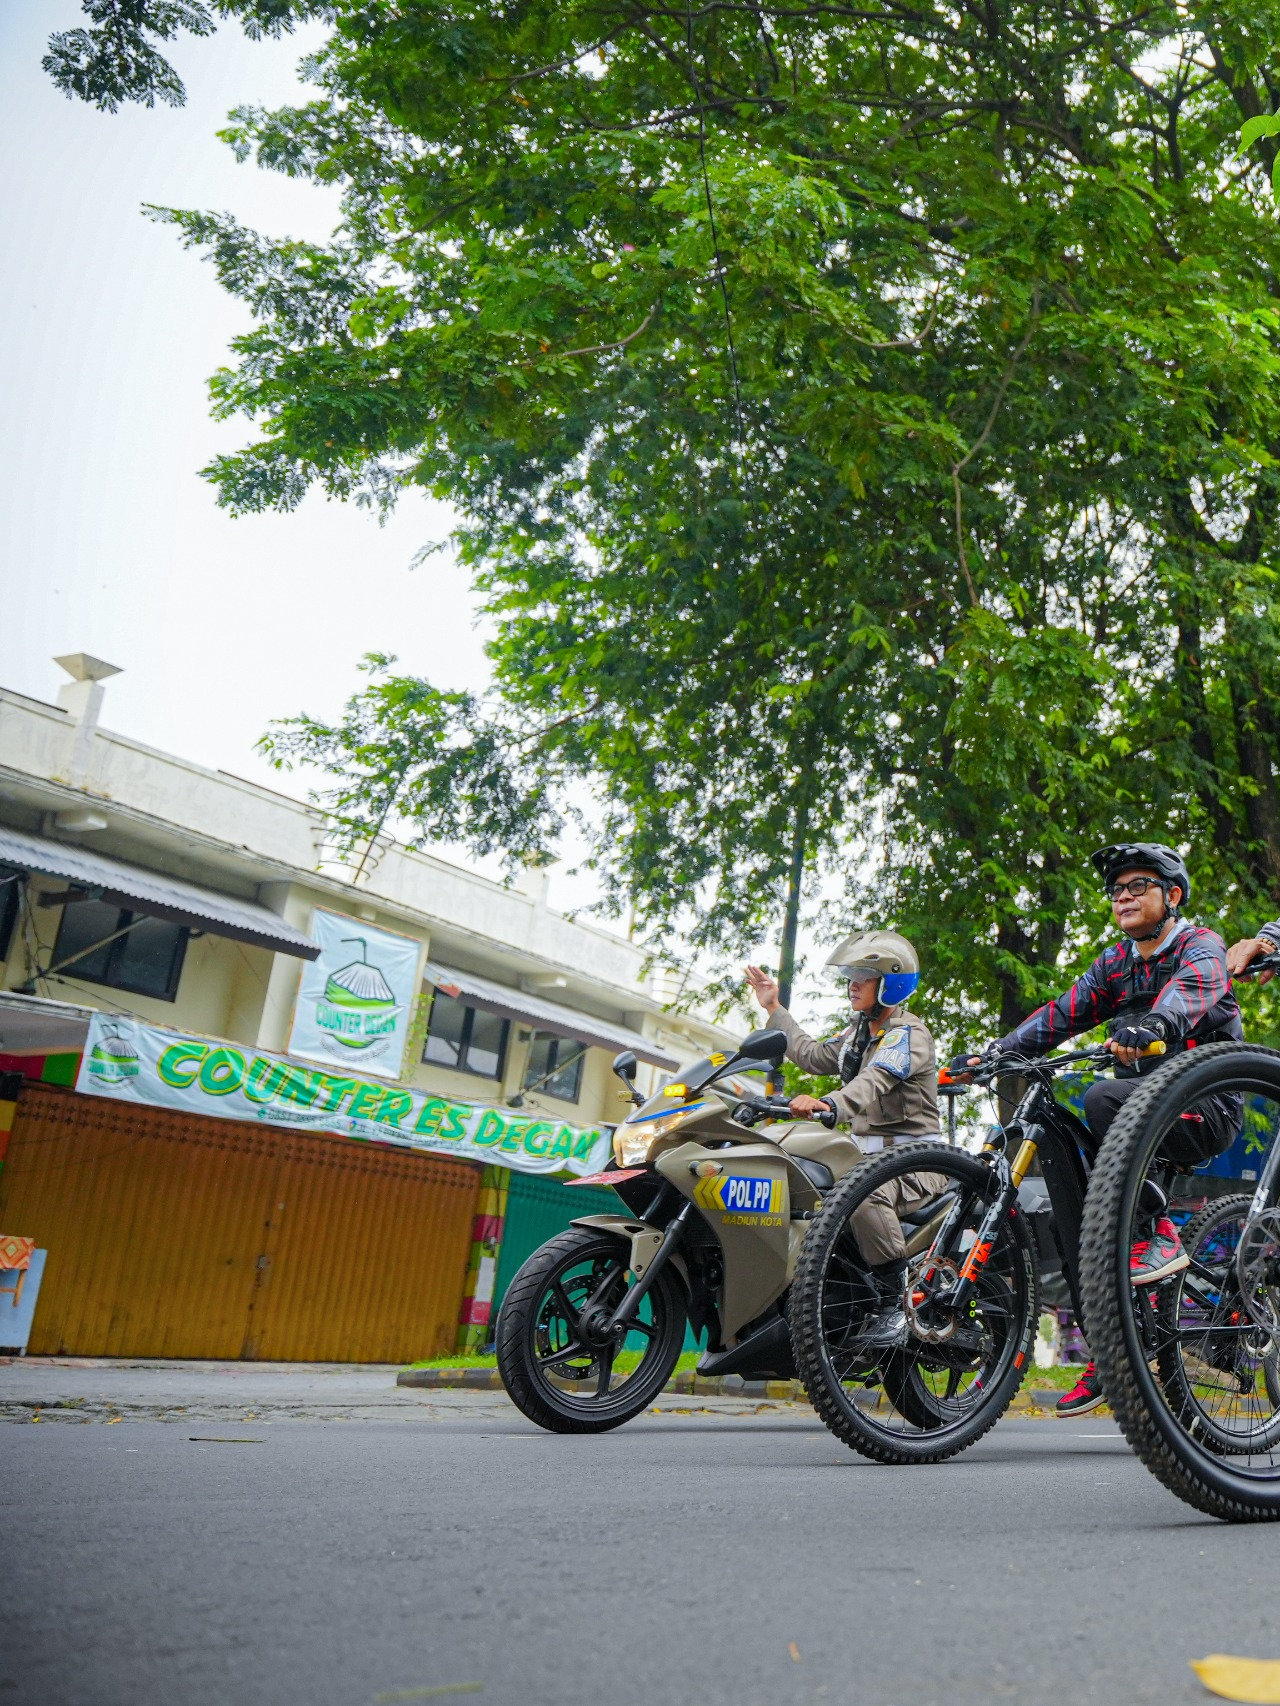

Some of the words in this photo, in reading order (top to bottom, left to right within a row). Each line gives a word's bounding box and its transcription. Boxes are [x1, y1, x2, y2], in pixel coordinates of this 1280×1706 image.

[316, 1003, 361, 1034] COUNTER
[156, 1040, 413, 1130] COUNTER
[412, 1096, 474, 1142] ES
[472, 1107, 601, 1164] DEGAN
[727, 1179, 752, 1208] POL
[753, 1181, 770, 1209] PP
[721, 1215, 758, 1226] MADIUN
[760, 1215, 782, 1227] KOTA
[1020, 1248, 1035, 1354] SCHWALBE
